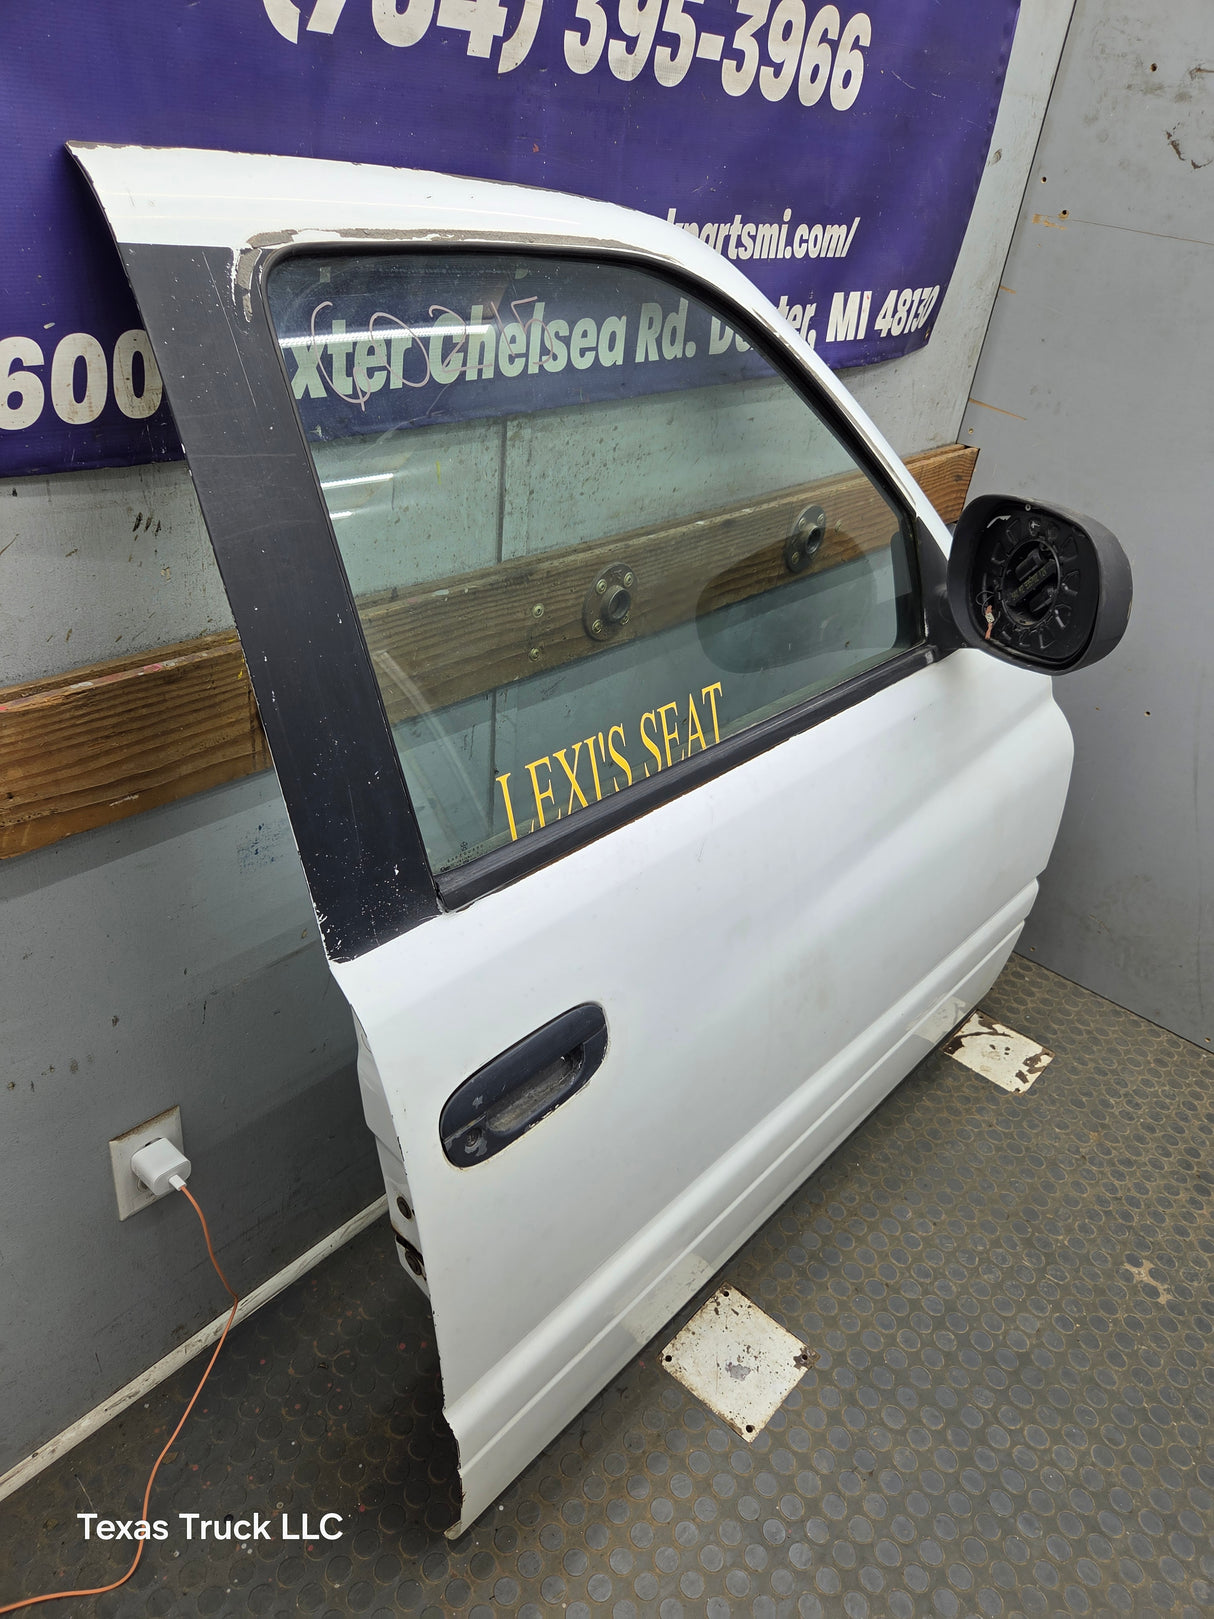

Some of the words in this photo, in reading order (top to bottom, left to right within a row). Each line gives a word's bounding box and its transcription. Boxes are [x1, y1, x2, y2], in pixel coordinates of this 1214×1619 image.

[429, 302, 627, 384] Chelsea
[635, 297, 697, 363] Rd.
[826, 290, 873, 343] MI
[874, 285, 941, 338] 48130
[495, 722, 634, 842] LEXI'S
[640, 681, 723, 777] SEAT
